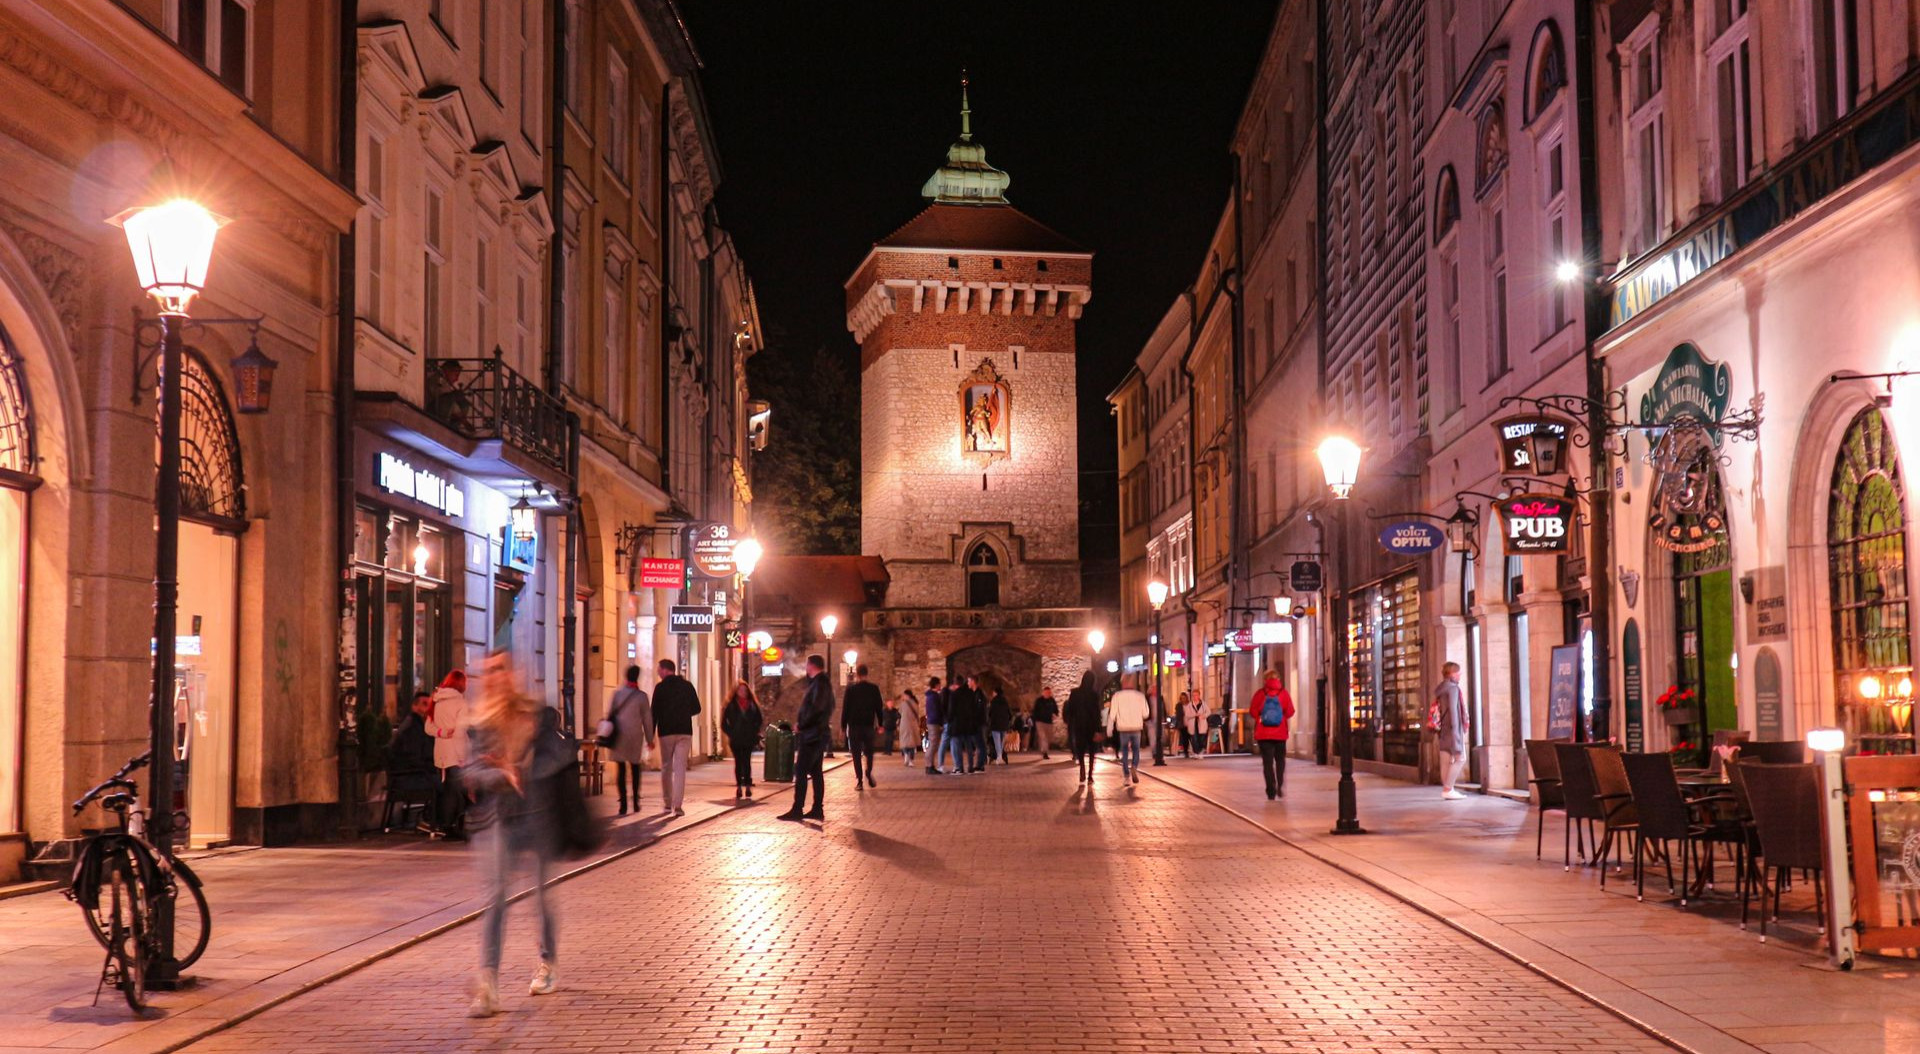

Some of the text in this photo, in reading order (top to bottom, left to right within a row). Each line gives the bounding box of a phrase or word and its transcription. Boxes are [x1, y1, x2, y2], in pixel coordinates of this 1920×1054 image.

[1661, 364, 1700, 391] KAWIARNIA
[1670, 383, 1717, 422] MICHALIKA
[710, 525, 729, 539] 36
[1510, 517, 1565, 538] PUB
[1391, 536, 1432, 547] OPTYK
[644, 562, 681, 570] KANTOR
[643, 575, 680, 584] EXCHANGE
[671, 613, 713, 625] TATTOO
